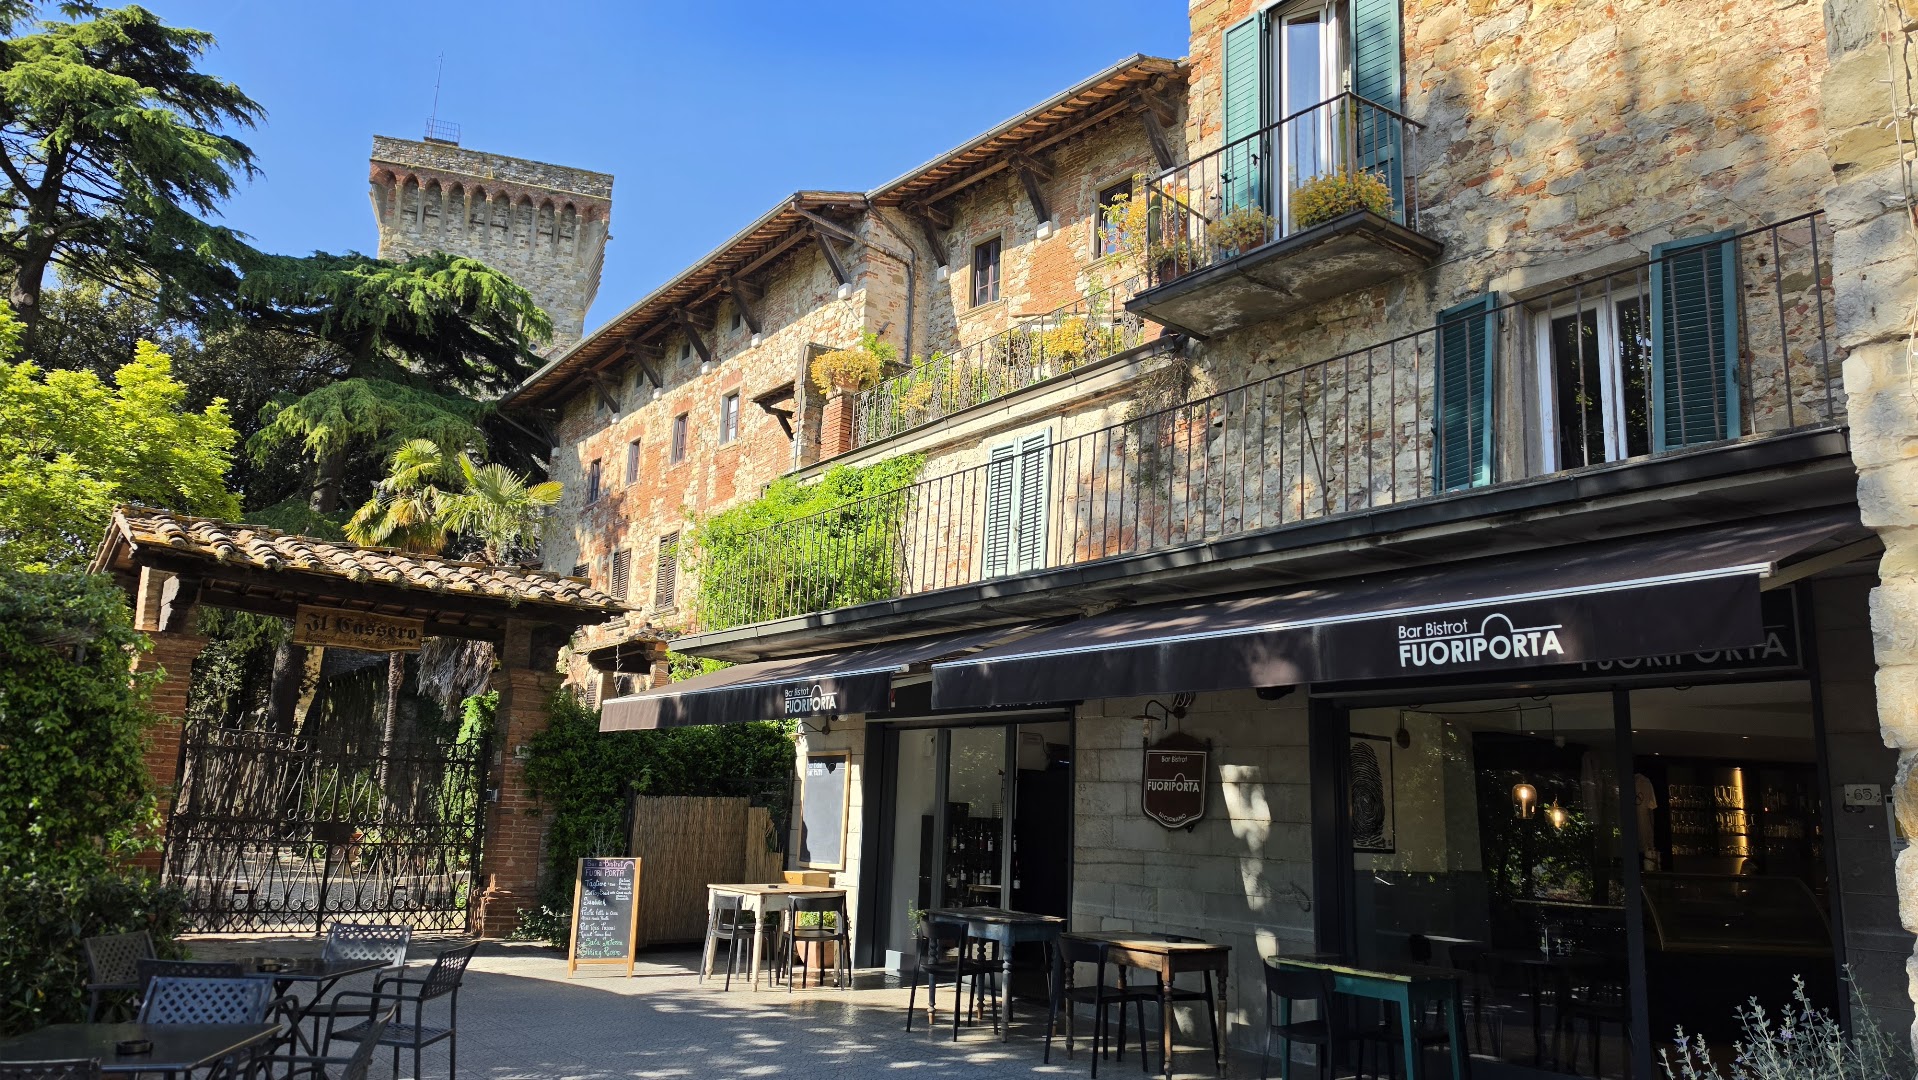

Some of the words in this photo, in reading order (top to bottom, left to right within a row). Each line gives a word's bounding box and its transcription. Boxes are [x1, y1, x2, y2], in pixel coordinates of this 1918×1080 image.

[335, 616, 417, 640] Cassero
[1398, 625, 1421, 639] Bar
[1425, 618, 1468, 637] Bistrot
[1399, 630, 1565, 668] FUORIPORTA
[785, 689, 793, 698] Bar
[794, 686, 809, 697] Bistrot
[784, 695, 837, 714] FUORIPORTA
[1161, 755, 1171, 763] Bar
[1171, 755, 1188, 763] Bistrot
[1147, 781, 1200, 793] FUORIPORTA
[1853, 788, 1873, 801] 65
[1158, 811, 1187, 822] LUCIGNANO
[604, 868, 625, 878] PORTA
